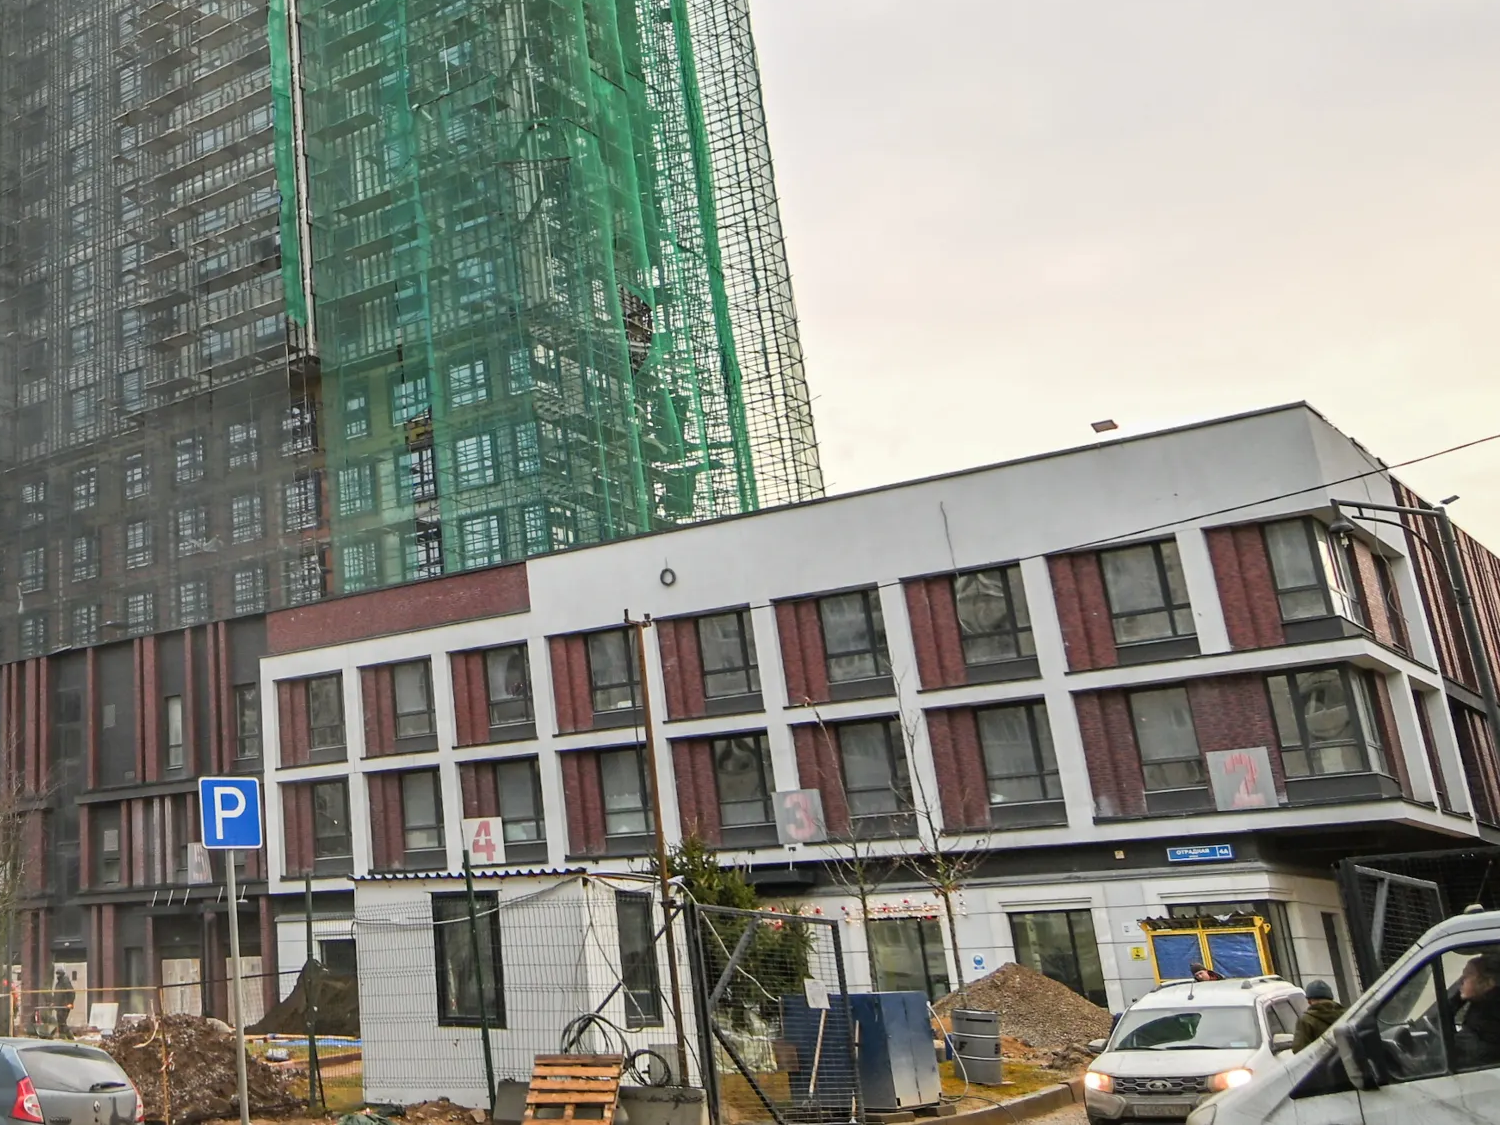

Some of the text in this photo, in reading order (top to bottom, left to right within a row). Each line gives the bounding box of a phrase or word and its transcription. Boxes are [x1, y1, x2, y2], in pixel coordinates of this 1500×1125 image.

[1224, 753, 1266, 808] 2
[213, 786, 247, 840] P
[783, 793, 815, 841] 3
[472, 820, 496, 862] 4
